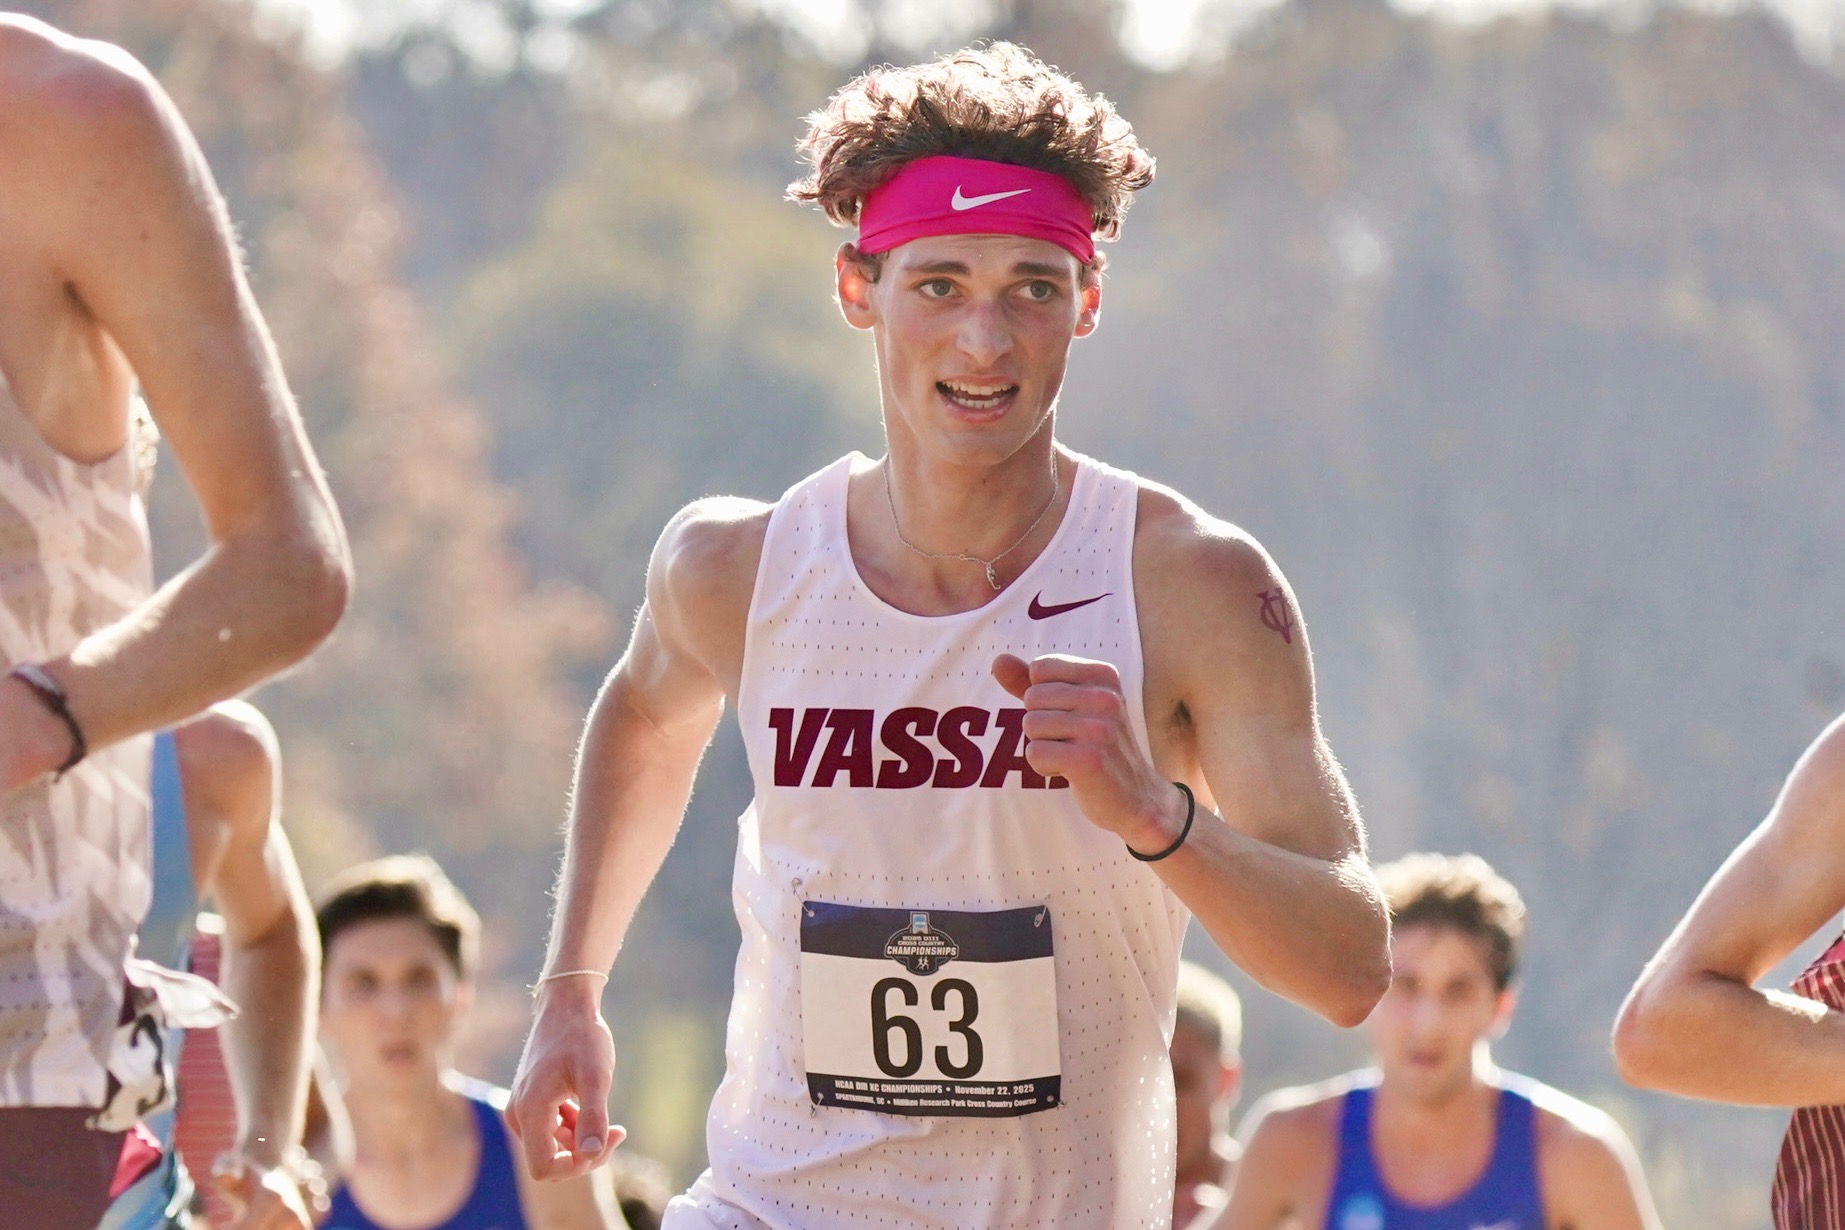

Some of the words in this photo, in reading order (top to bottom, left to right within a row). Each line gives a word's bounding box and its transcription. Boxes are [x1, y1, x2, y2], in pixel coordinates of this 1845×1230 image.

[768, 706, 1070, 790] VASSA
[887, 946, 957, 955] CHAMPIONSHIPS
[870, 976, 984, 1080] 63
[835, 1080, 854, 1090] NCAA
[869, 1082, 880, 1092] XC
[881, 1083, 943, 1094] CHAMPIONSHIPS
[955, 1085, 995, 1095] November
[997, 1086, 1011, 1096] 22,
[1013, 1084, 1034, 1095] 2025
[920, 1098, 950, 1107] Research
[951, 1099, 966, 1108] Park
[967, 1099, 986, 1108] Cross
[986, 1099, 1013, 1109] Country
[1013, 1097, 1037, 1107] Course
